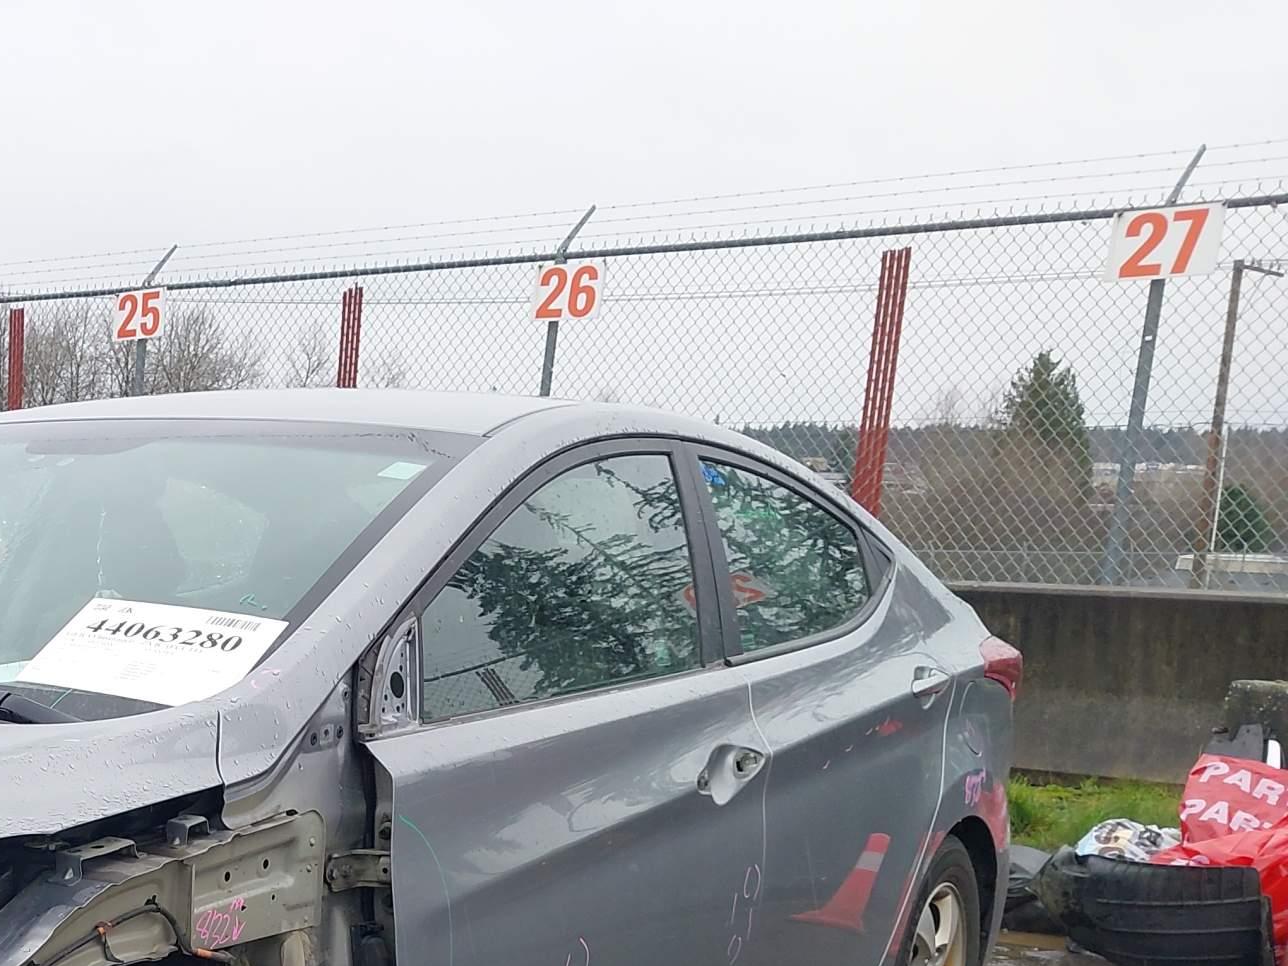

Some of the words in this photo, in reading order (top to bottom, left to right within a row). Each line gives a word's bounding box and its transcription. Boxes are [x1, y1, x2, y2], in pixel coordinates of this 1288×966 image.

[1118, 208, 1209, 279] 27
[535, 264, 599, 319] 26
[116, 291, 161, 339] 25
[86, 618, 243, 651] 44063280
[1199, 761, 1288, 806] PAR
[1180, 799, 1273, 832] PAR
